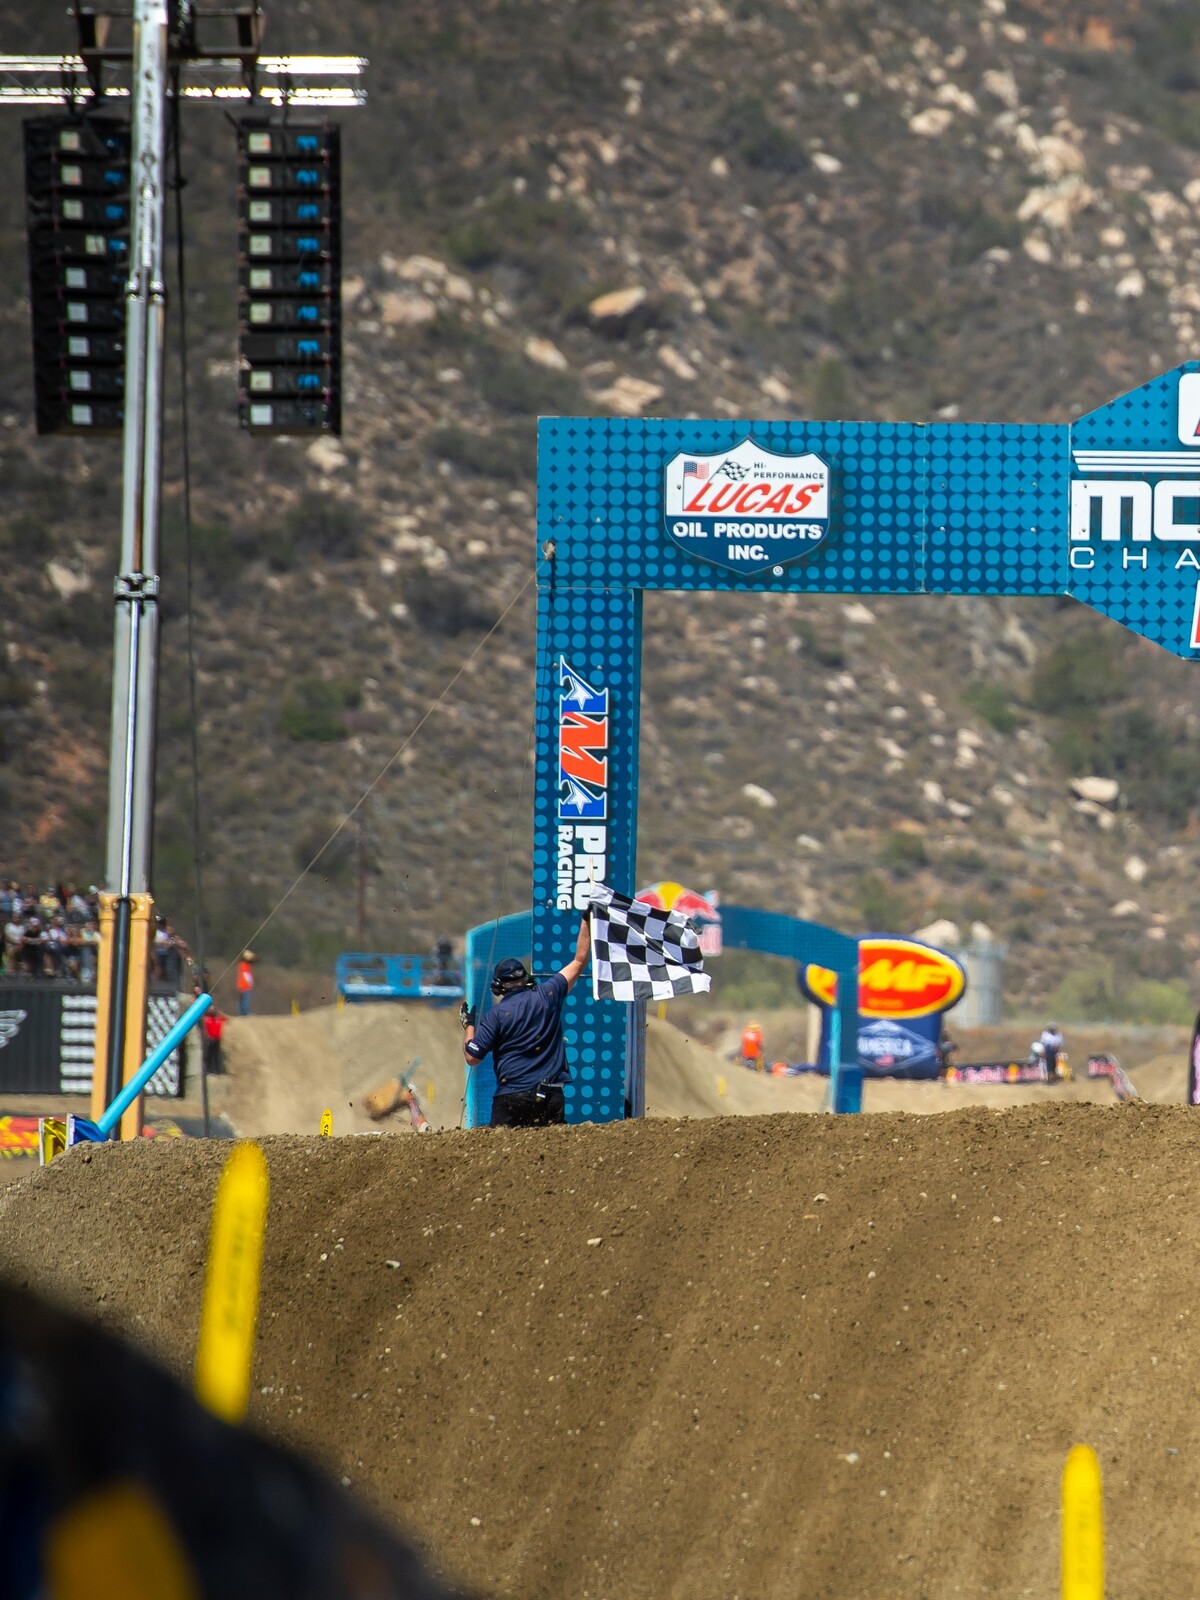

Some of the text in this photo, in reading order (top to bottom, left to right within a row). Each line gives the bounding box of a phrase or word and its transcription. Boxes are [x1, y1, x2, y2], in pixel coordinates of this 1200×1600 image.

[753, 471, 825, 480] PERFORMANCE
[683, 482, 821, 514] LUCAS
[673, 521, 823, 540] OIL PRODUCTS
[727, 544, 769, 561] INC.
[556, 824, 574, 911] RACING
